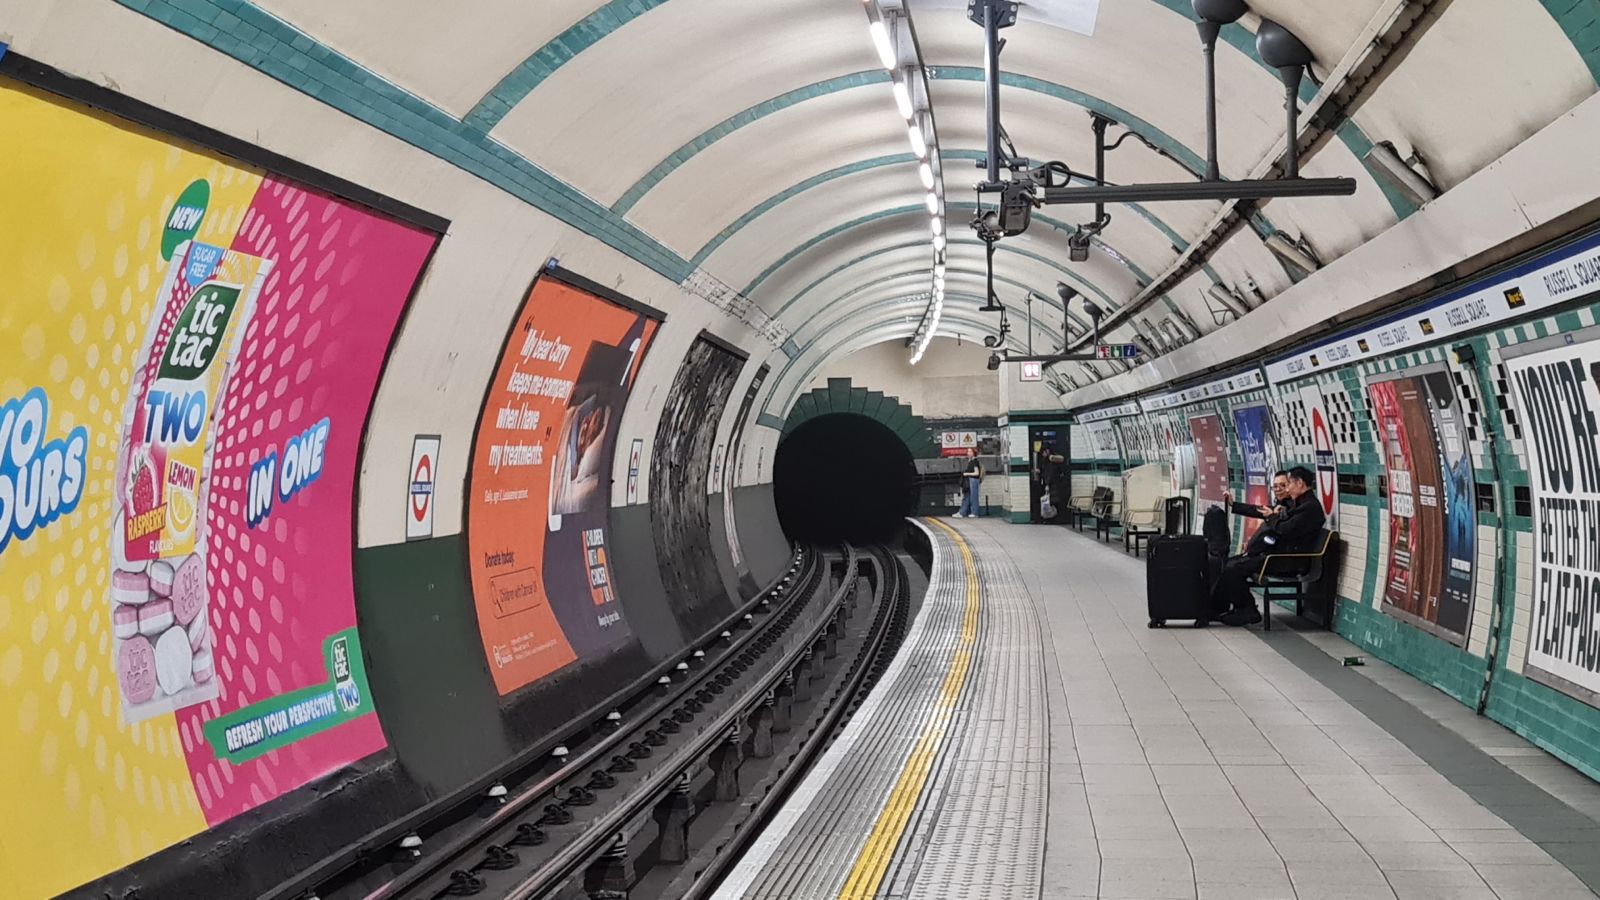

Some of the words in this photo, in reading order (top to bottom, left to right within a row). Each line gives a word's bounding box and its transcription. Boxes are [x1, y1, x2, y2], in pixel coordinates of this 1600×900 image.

[168, 205, 203, 231] NEW
[190, 262, 206, 278] FREE
[192, 246, 215, 263] SUGAR
[1543, 267, 1577, 297] RUSSELL
[189, 291, 225, 335] tic
[169, 327, 213, 368] tac
[145, 389, 206, 443] TWO
[1513, 358, 1600, 495] YOU'RE
[168, 461, 196, 491] LEMON
[248, 456, 276, 525] IN
[279, 422, 328, 497] ONE
[1427, 397, 1450, 515] LIGHTROOM
[128, 502, 168, 542] RASPBERRY
[1539, 497, 1580, 570] BETTER
[1580, 499, 1600, 573] TH
[1535, 566, 1600, 674] FLAT-PAC
[333, 644, 347, 663] tic
[334, 661, 348, 678] tac
[337, 682, 360, 712] TWO
[225, 720, 265, 753] REFRESH
[263, 709, 290, 736] YOUR
[288, 691, 337, 727] PERSPECTIVE
